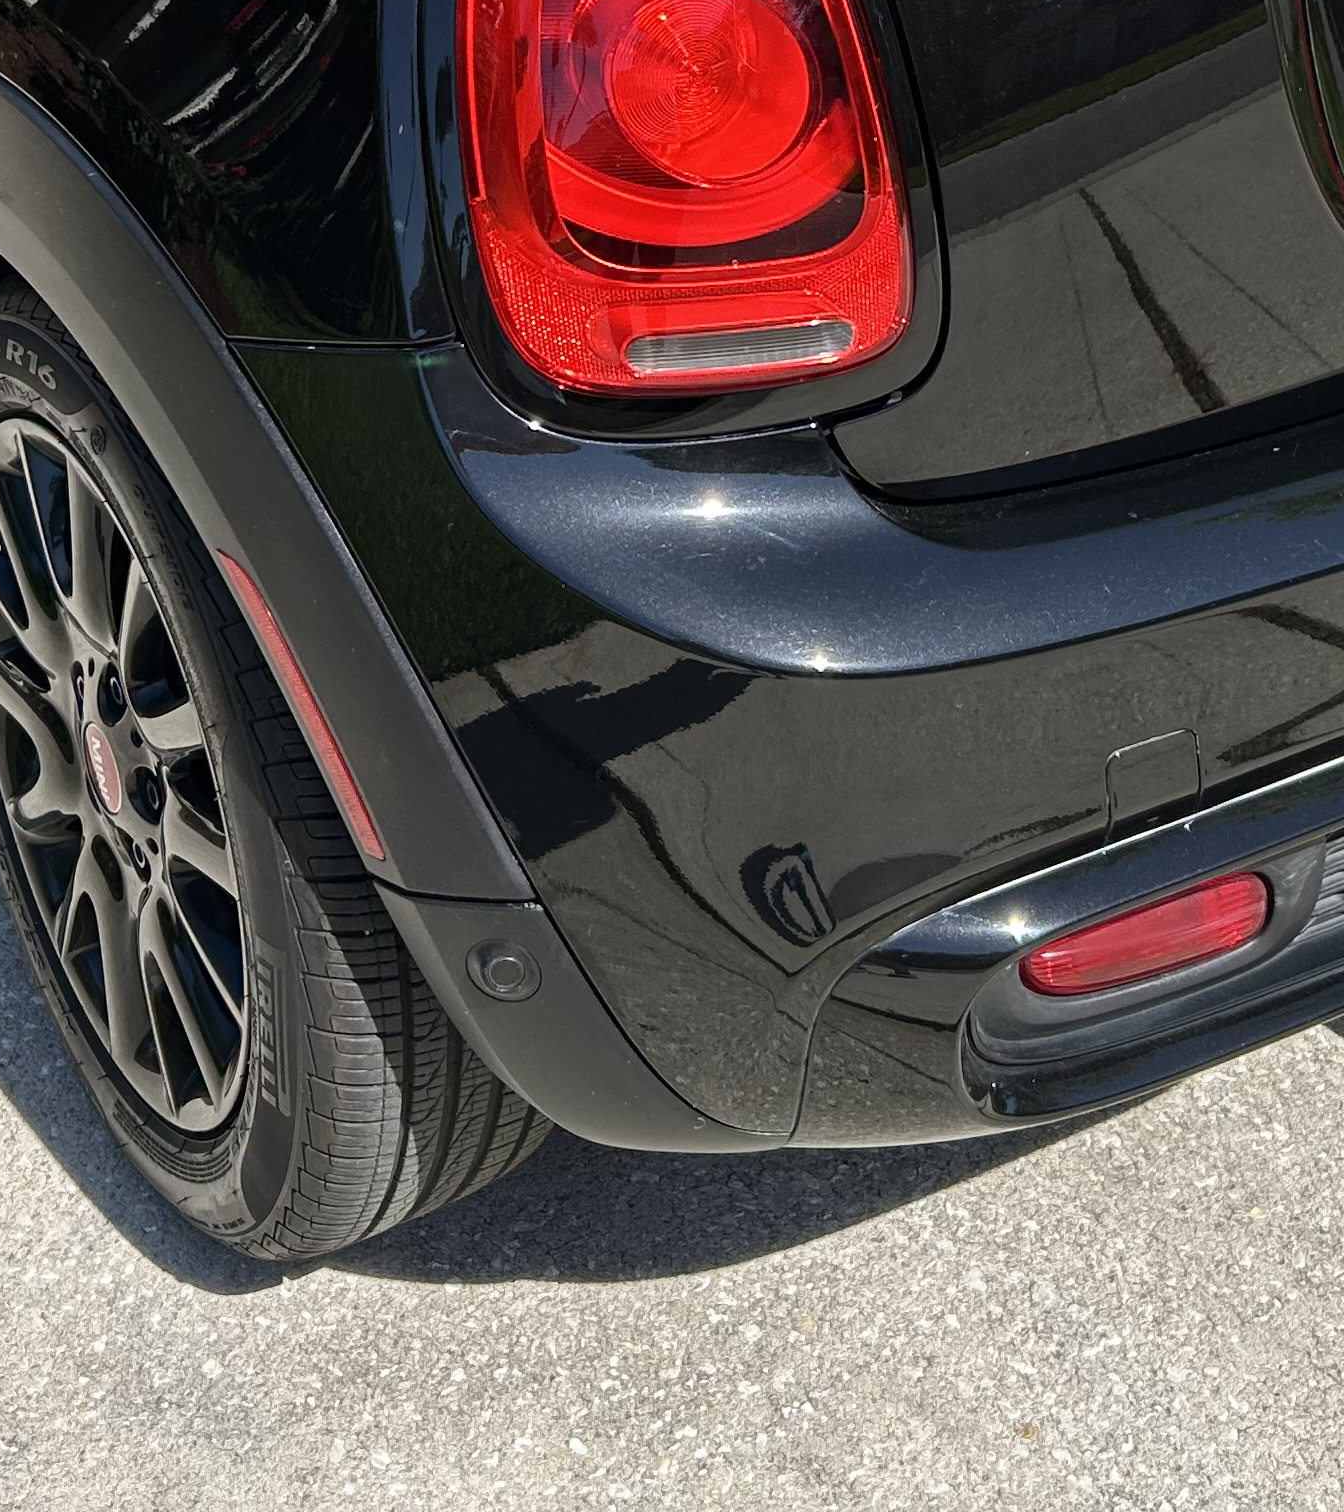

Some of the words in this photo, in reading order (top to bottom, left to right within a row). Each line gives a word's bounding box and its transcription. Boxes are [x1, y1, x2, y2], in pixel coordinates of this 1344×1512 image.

[5, 338, 58, 391] R16
[91, 736, 112, 803] MINI
[254, 933, 292, 1118] PIRELLI
